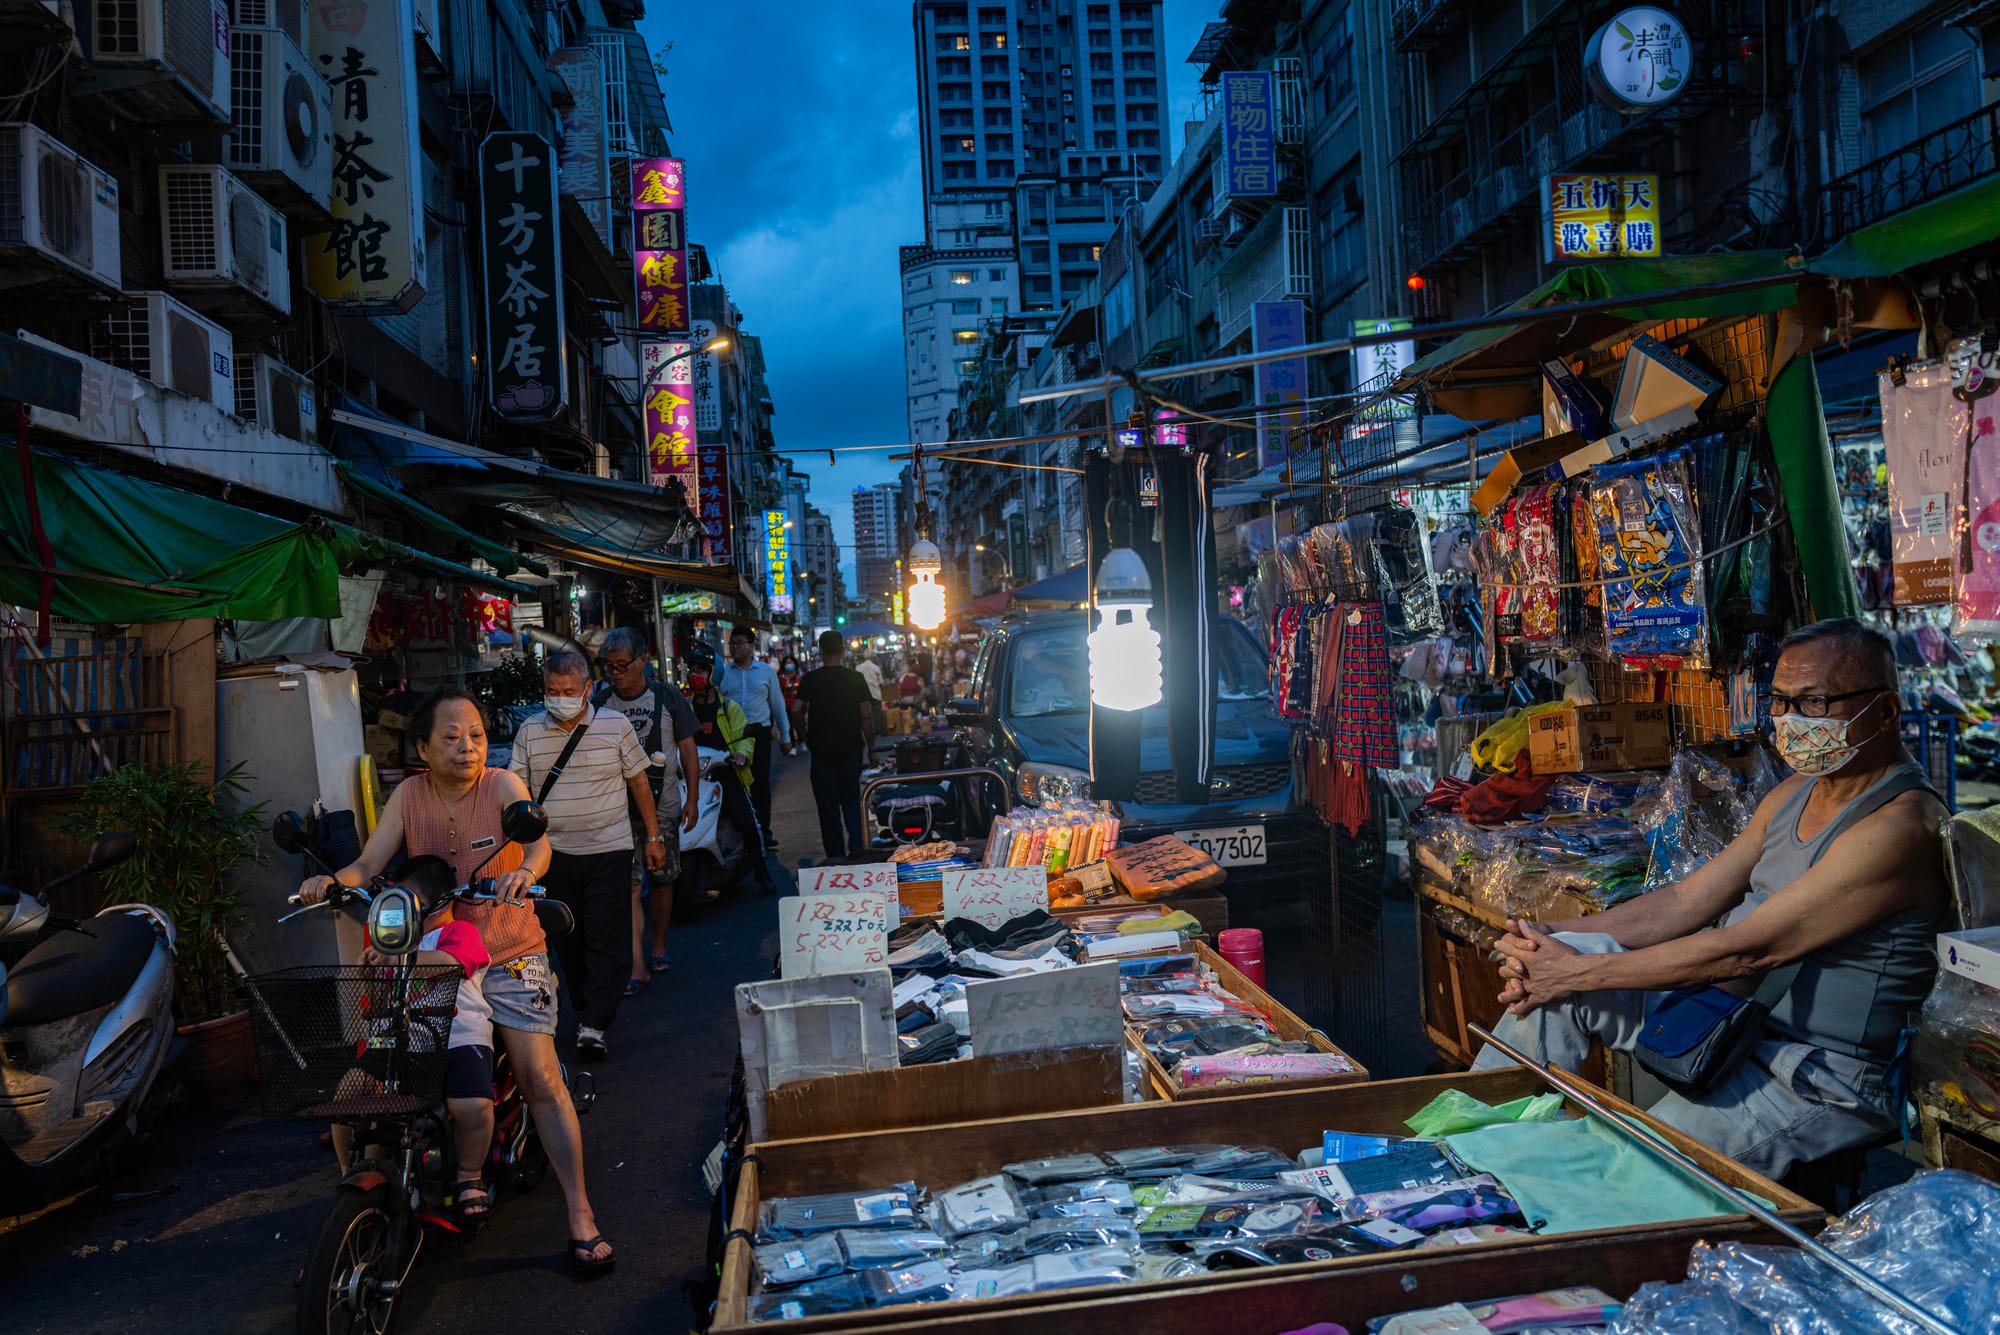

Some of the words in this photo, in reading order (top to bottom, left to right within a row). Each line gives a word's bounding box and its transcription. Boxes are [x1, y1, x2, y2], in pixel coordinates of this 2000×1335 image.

[320, 46, 394, 283] 清茶館
[1228, 76, 1270, 192] 寵物住宿
[1558, 179, 1654, 210] 五折天
[495, 141, 551, 377] 十方茶居
[637, 169, 684, 329] 鑫園健康
[1560, 221, 1655, 254] 歡喜購
[1266, 306, 1298, 390] 第一物
[648, 388, 691, 469] 會館
[1635, 709, 1664, 722] 9545
